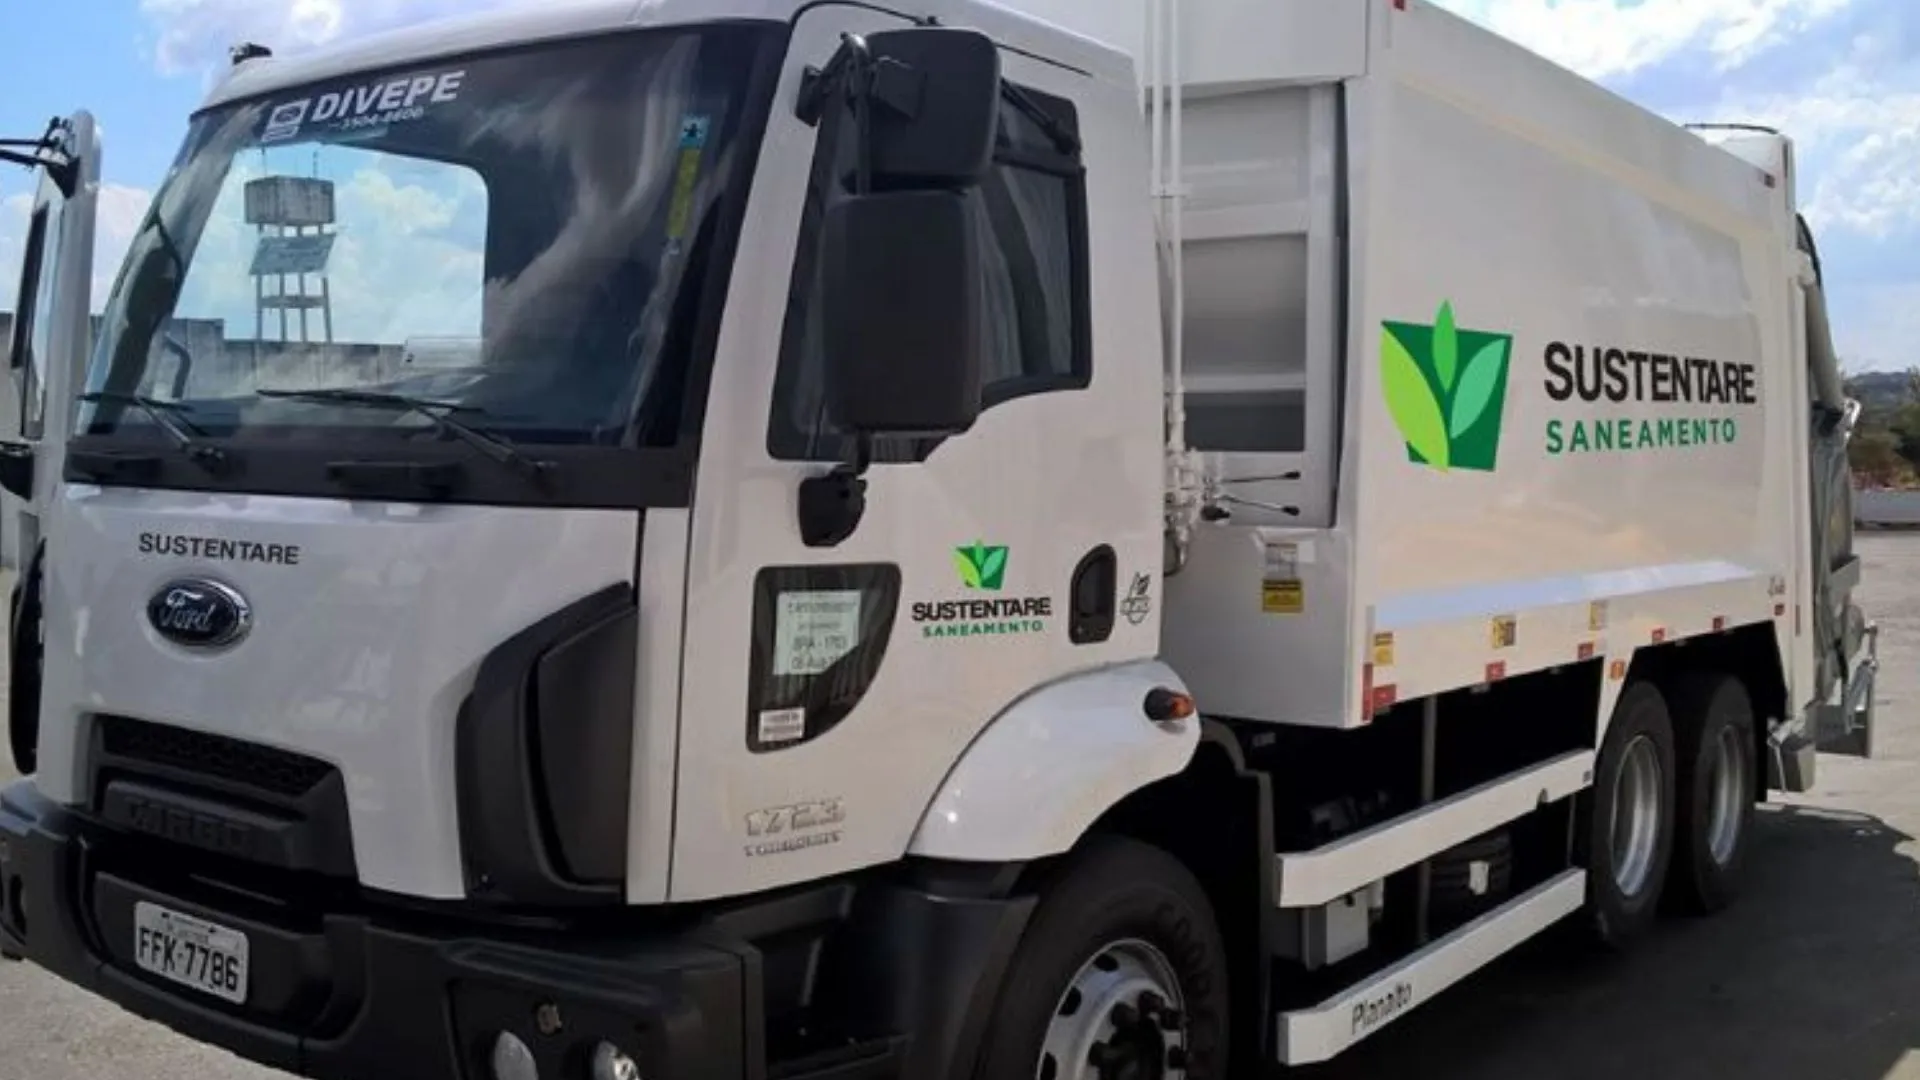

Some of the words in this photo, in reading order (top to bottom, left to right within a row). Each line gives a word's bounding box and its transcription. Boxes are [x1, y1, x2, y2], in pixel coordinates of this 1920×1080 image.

[311, 70, 465, 122] DIVEPE
[1544, 341, 1757, 405] SUSTENTARE
[1545, 417, 1737, 454] SANEAMENTO
[139, 531, 300, 565] SUSTENTARE
[159, 587, 217, 632] Ford
[912, 596, 1052, 622] SUSTENTARE
[922, 620, 1044, 638] SANEAMENTO
[138, 925, 239, 992] FFK-7786
[1351, 982, 1413, 1036] Planalto
